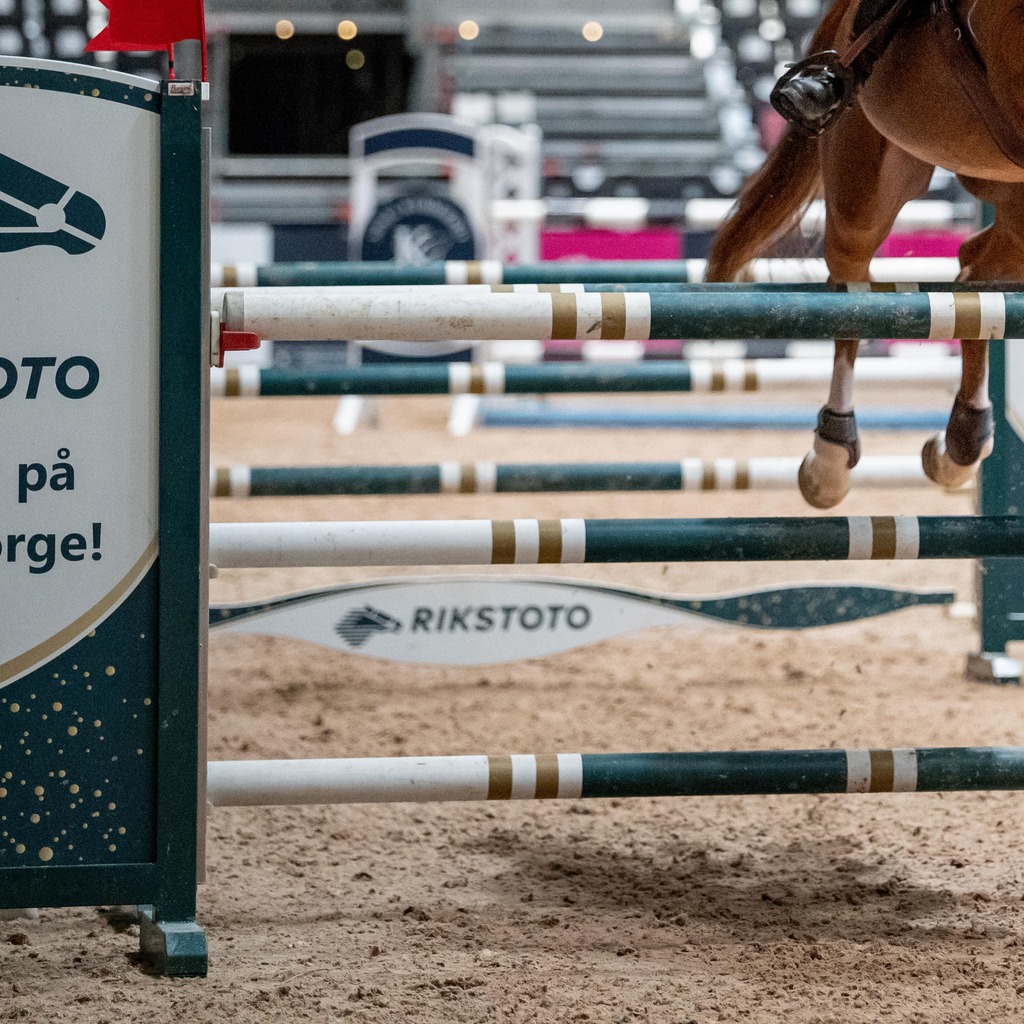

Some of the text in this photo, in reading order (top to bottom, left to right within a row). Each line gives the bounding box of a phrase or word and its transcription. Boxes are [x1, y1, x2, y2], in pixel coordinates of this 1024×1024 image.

[18, 447, 75, 504] på
[0, 522, 102, 575] rge!
[410, 604, 592, 634] RIKSTOTO
